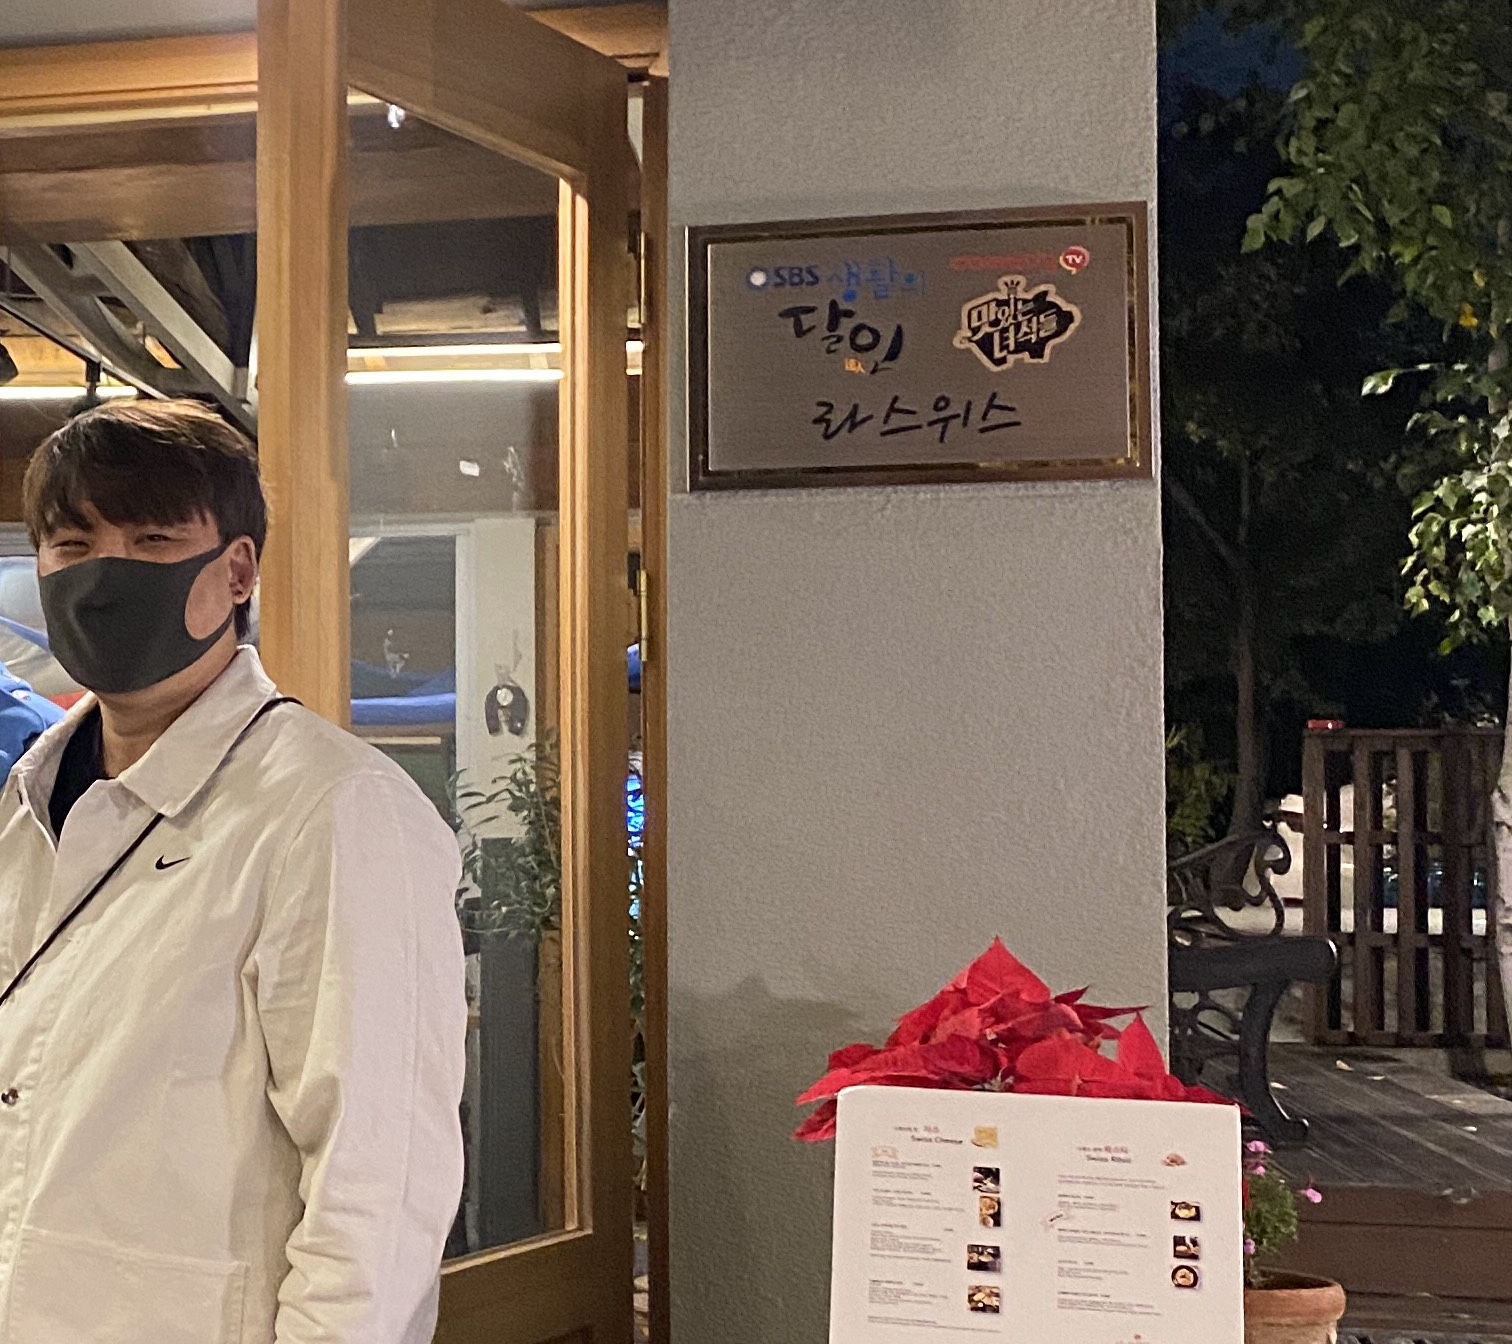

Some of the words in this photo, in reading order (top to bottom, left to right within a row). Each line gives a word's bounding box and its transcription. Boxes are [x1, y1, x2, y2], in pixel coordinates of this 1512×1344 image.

[774, 265, 820, 288] SBS
[778, 299, 902, 375] 달인
[970, 295, 1036, 341] 맛있는
[992, 308, 1058, 359] 녀석들
[812, 391, 1022, 444] 라스위스
